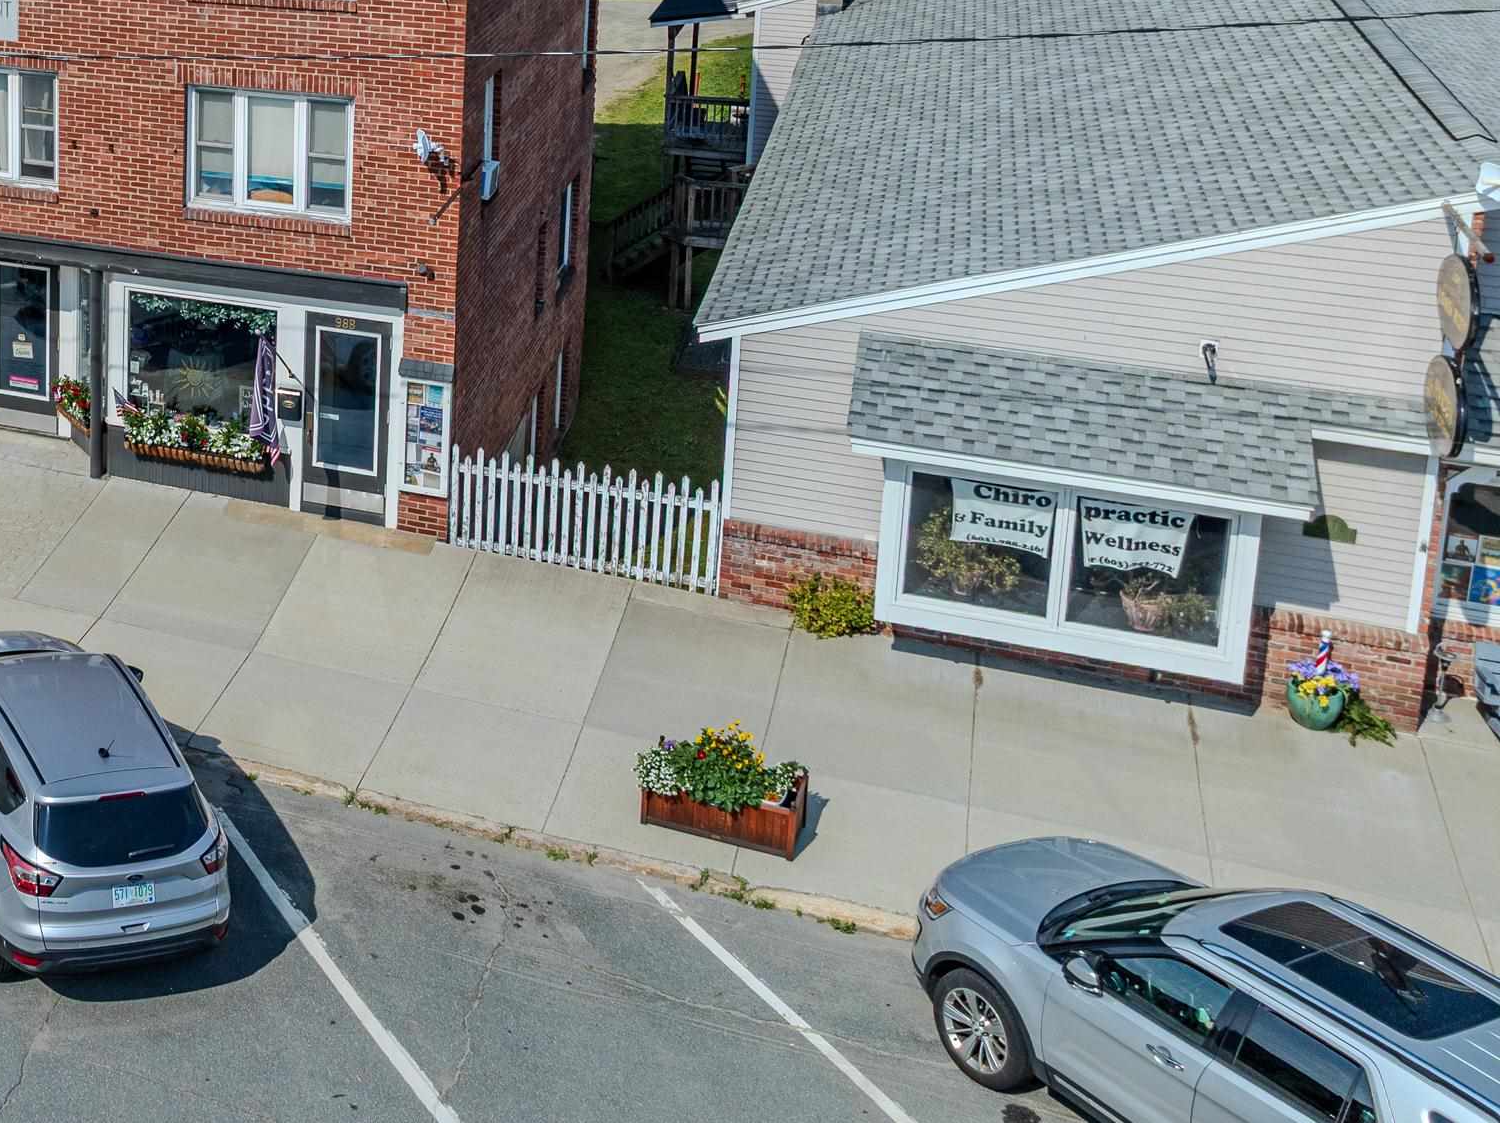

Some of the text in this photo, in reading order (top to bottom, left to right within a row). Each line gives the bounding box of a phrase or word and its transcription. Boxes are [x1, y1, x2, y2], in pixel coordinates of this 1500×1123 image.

[334, 317, 357, 330] 98B
[973, 484, 1186, 529] Chiro practic
[954, 510, 1182, 557] & Family Wellness
